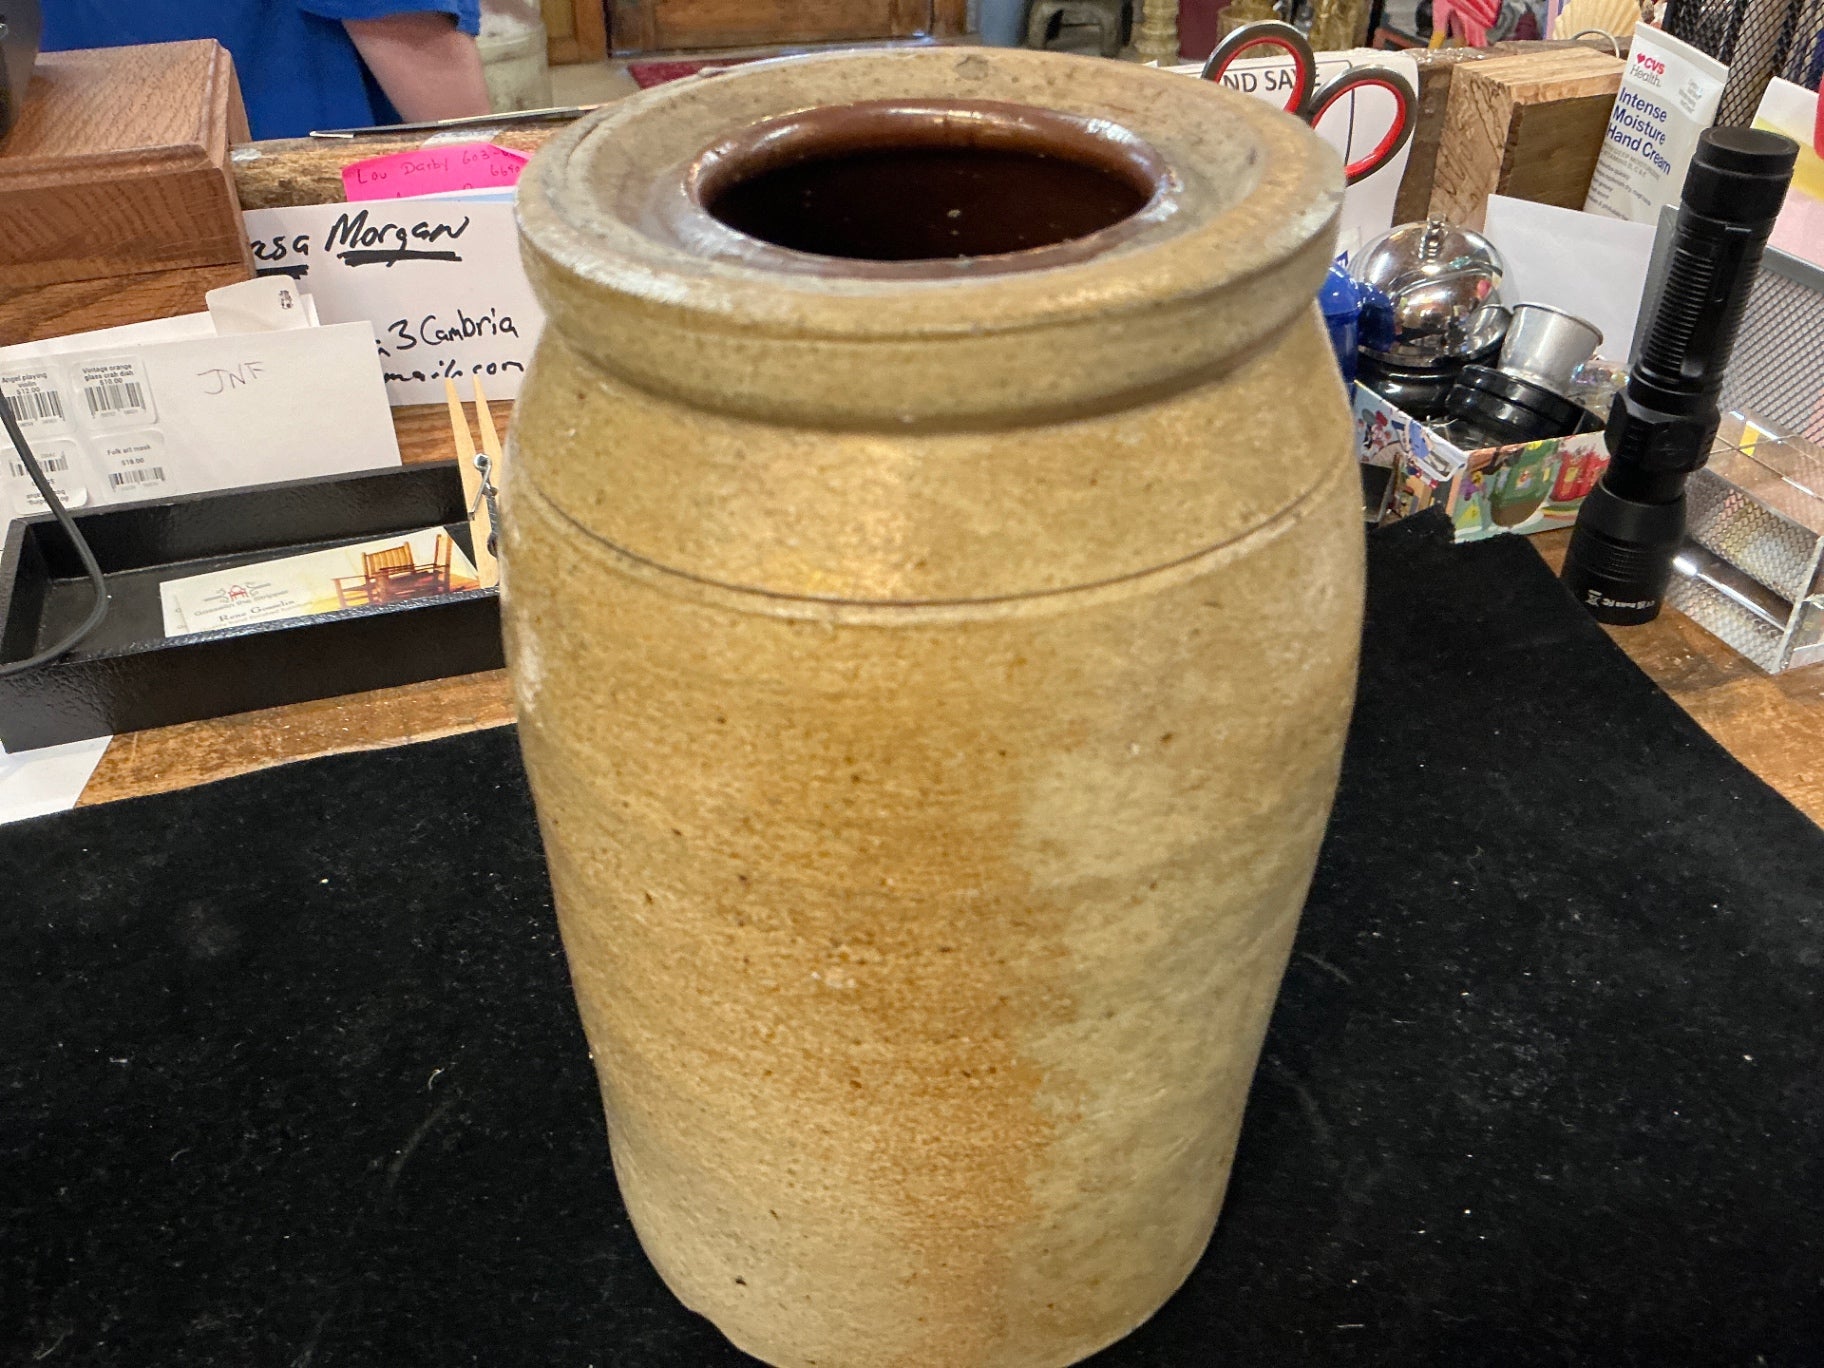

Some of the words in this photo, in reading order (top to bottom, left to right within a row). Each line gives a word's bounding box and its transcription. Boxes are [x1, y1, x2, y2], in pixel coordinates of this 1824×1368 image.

[1643, 57, 1665, 75] CVS
[1618, 87, 1667, 123] Intense
[1612, 105, 1666, 146] Moisture
[1606, 122, 1642, 151] Hand
[1642, 142, 1671, 175] Cream
[325, 209, 470, 262] Morgan
[420, 307, 519, 346] Cambria
